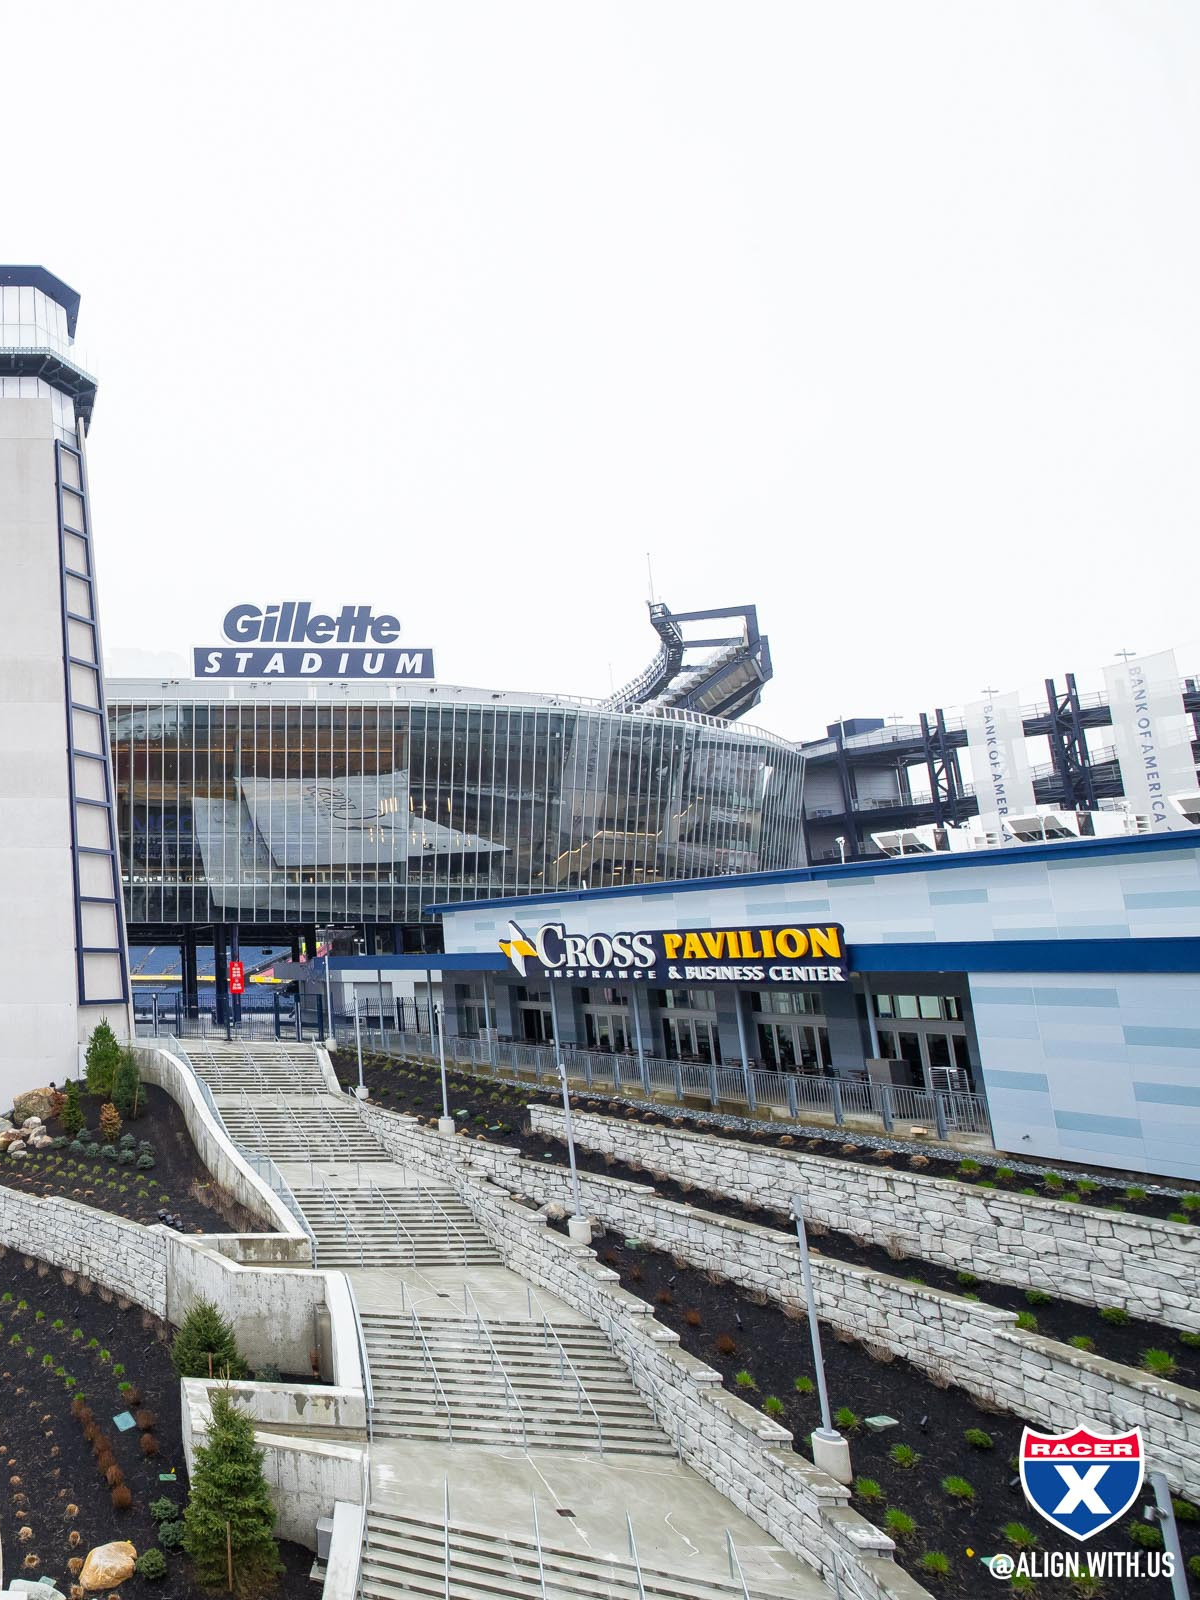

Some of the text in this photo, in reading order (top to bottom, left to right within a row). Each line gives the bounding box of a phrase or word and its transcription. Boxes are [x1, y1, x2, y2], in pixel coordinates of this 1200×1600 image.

[223, 602, 400, 643] Gillette
[204, 652, 423, 674] STADIUM
[1129, 666, 1167, 823] BANK OF AMERICA
[984, 705, 1013, 842] BANK OF AMERA
[536, 925, 656, 967] CROSS
[663, 927, 841, 960] PAVILION
[544, 970, 657, 979] INSURANCE
[668, 966, 846, 982] & BUSINESS CENTER
